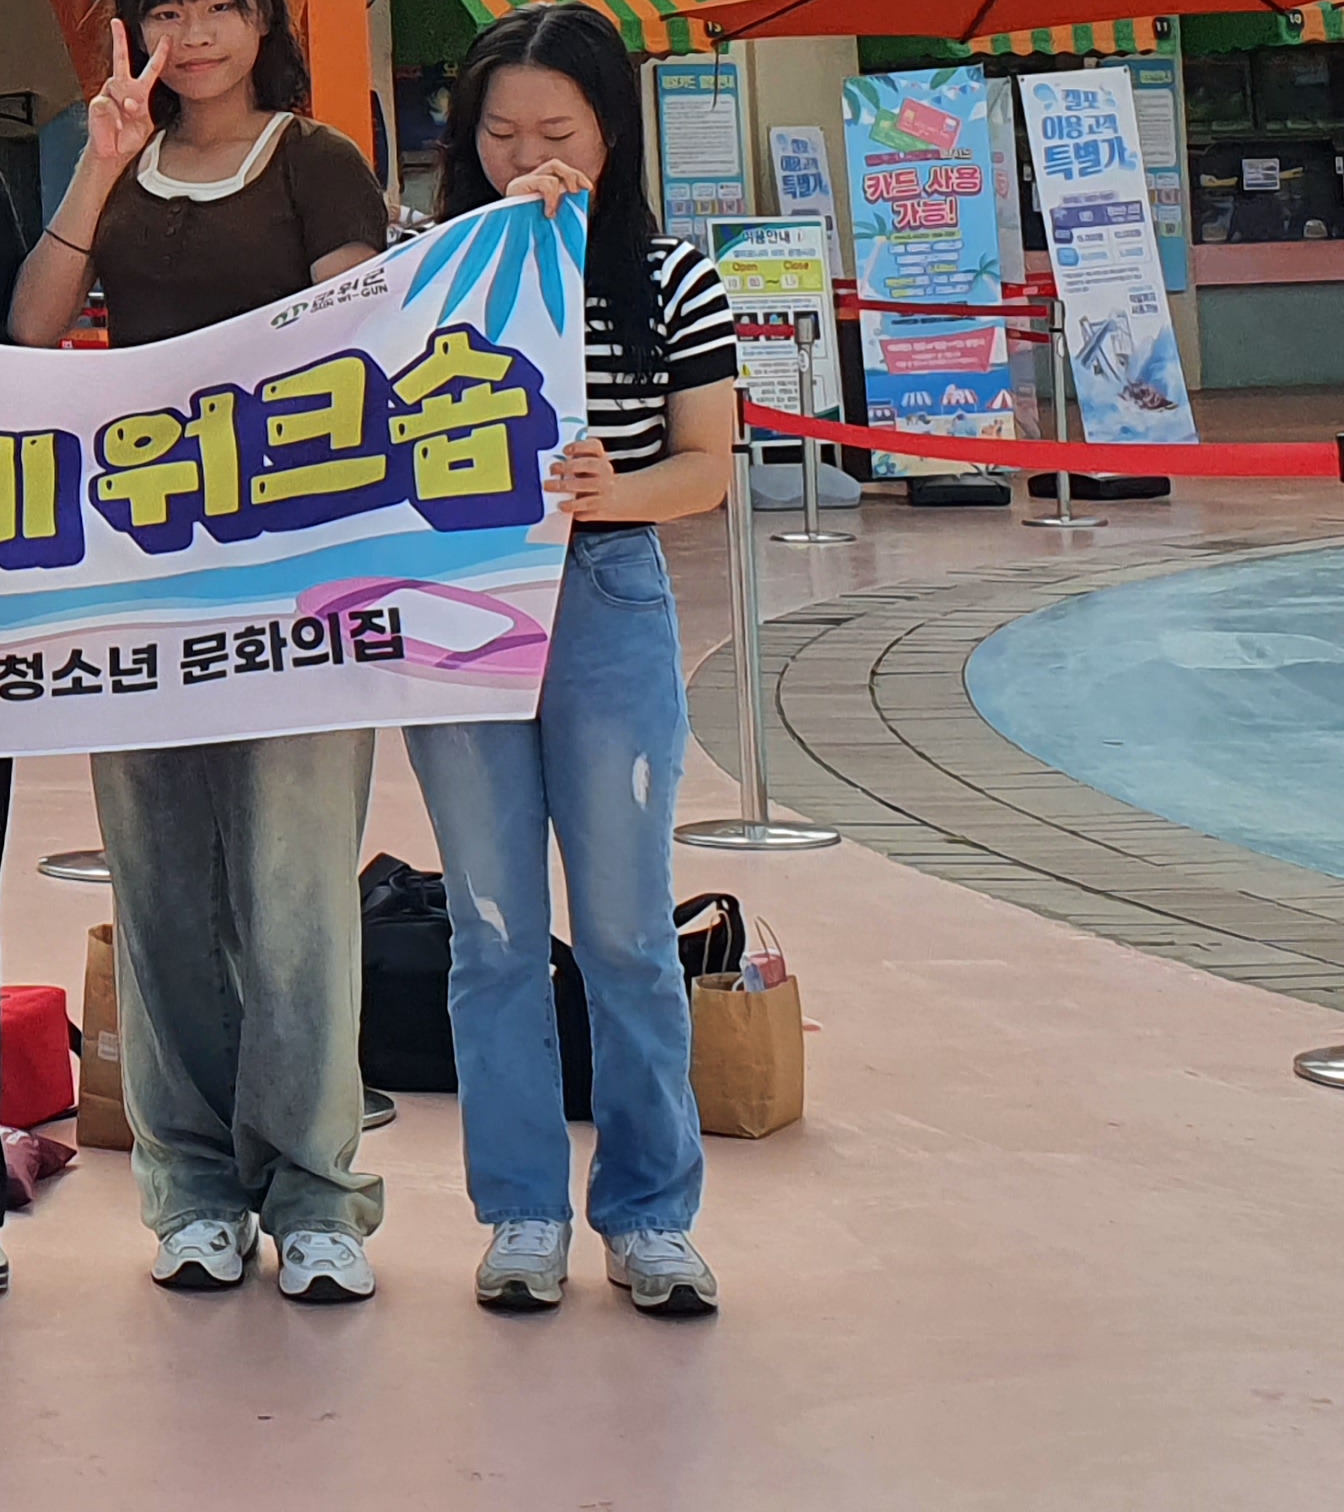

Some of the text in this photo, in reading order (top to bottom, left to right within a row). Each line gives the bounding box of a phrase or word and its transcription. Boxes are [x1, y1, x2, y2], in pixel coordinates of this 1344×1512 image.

[1043, 135, 1128, 180] 특별가
[864, 168, 921, 203] 카드
[924, 165, 983, 197] 사용
[893, 197, 959, 231] 가능!
[89, 325, 559, 555] 워크숍
